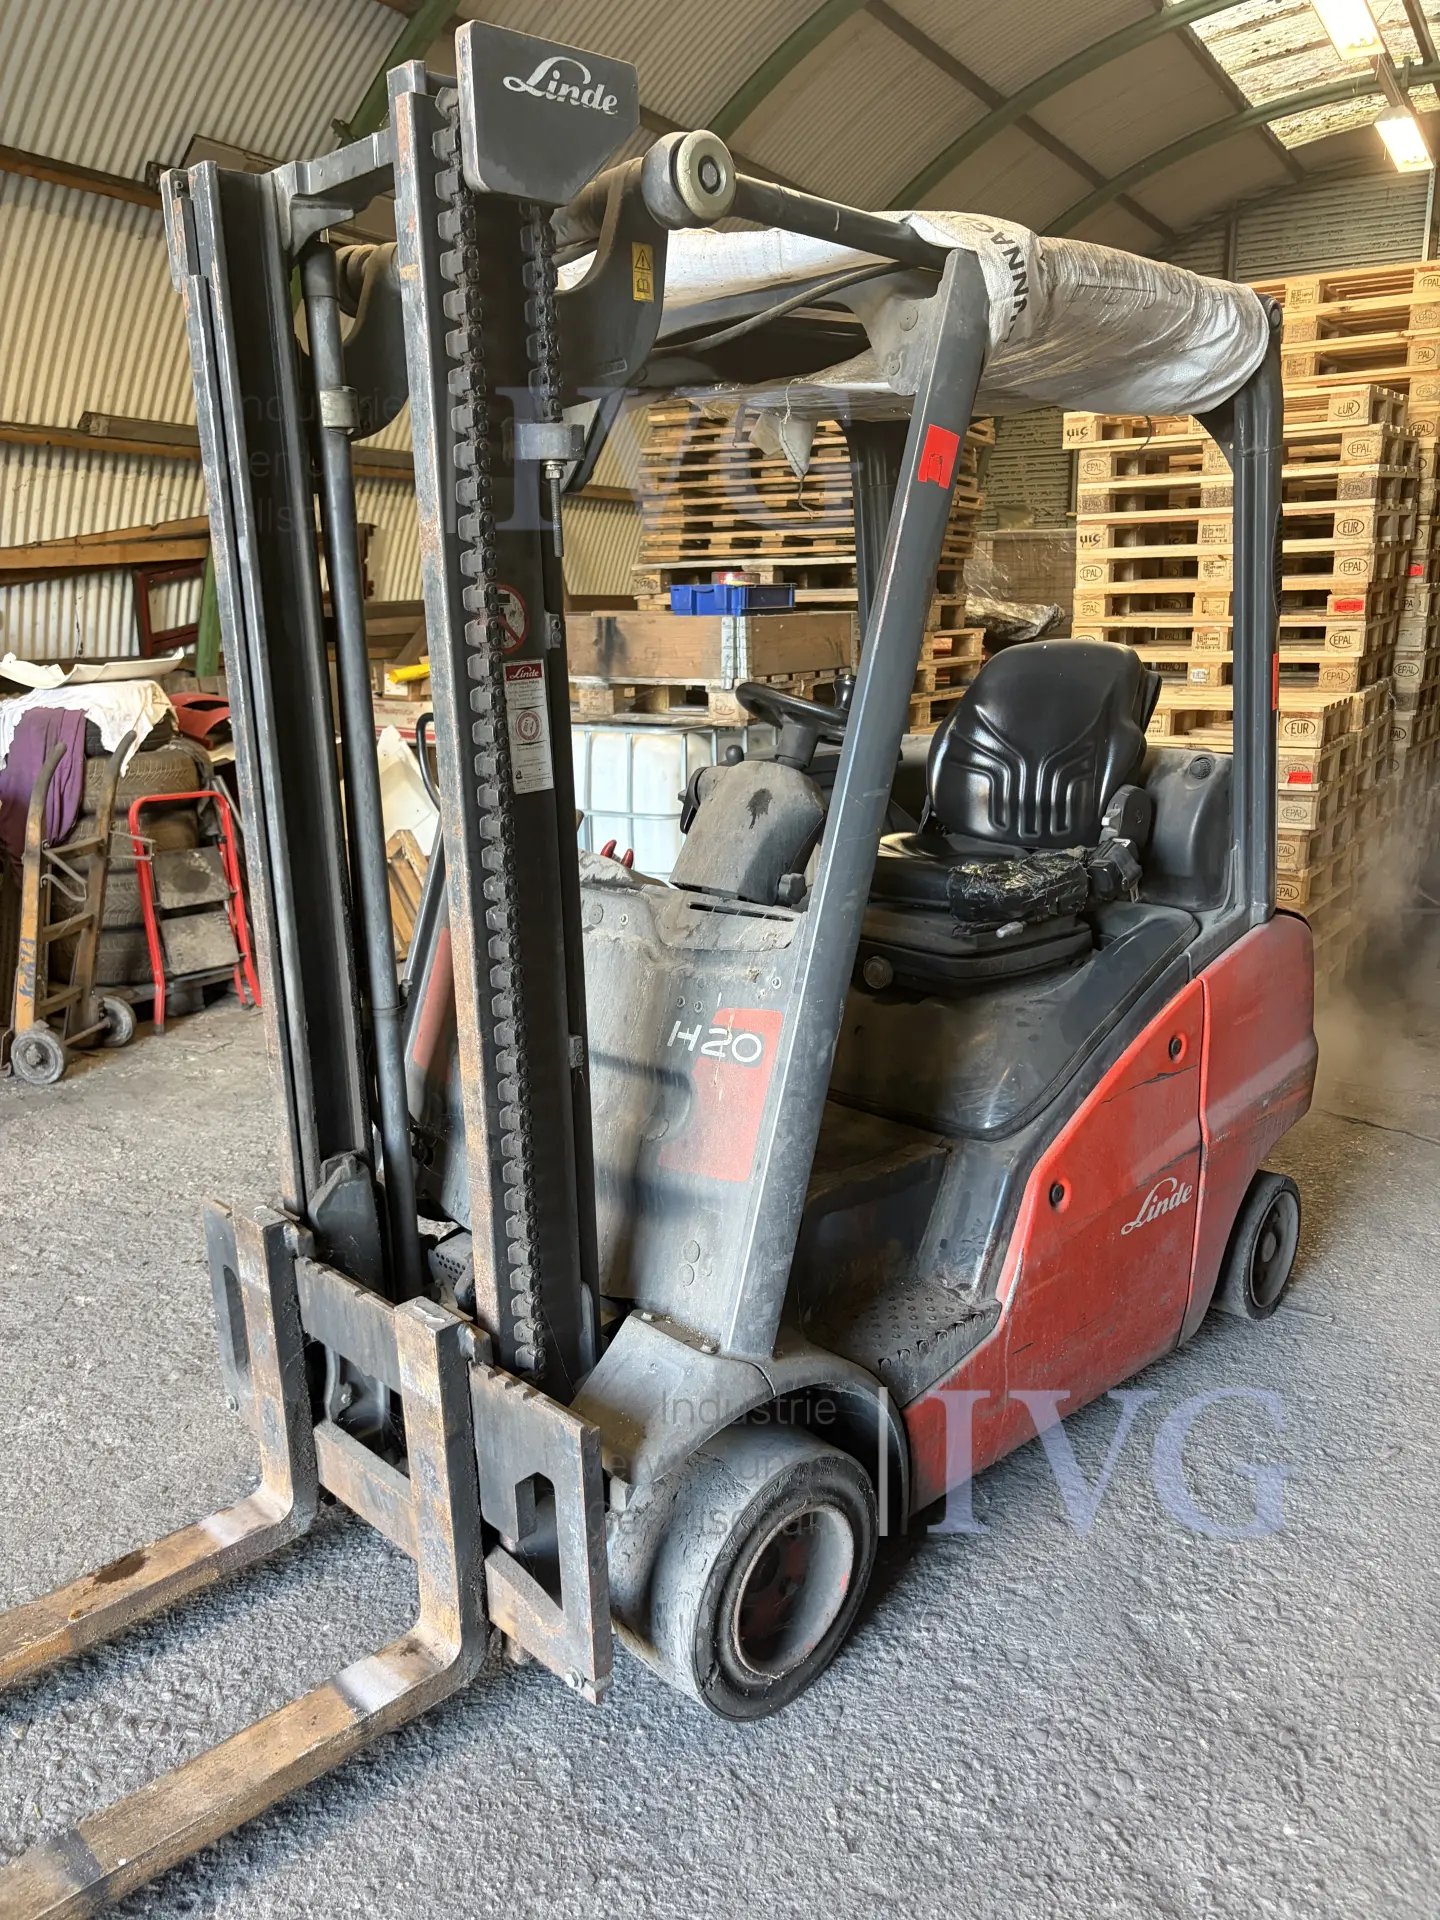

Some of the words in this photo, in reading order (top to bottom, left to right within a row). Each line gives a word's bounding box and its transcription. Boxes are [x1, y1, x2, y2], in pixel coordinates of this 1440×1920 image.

[503, 56, 618, 115] Linde
[1351, 443, 1372, 454] EPAL
[1342, 521, 1359, 534] EUR
[1343, 561, 1362, 572] EPAL
[1333, 636, 1353, 645] EPAL
[510, 665, 539, 680] Linde
[1398, 665, 1415, 674] EPAL
[1326, 673, 1345, 682] EPAL
[1290, 722, 1309, 735] EUR
[1285, 808, 1303, 817] EPAL
[667, 1020, 762, 1063] H20
[1120, 1176, 1193, 1236] Linde
